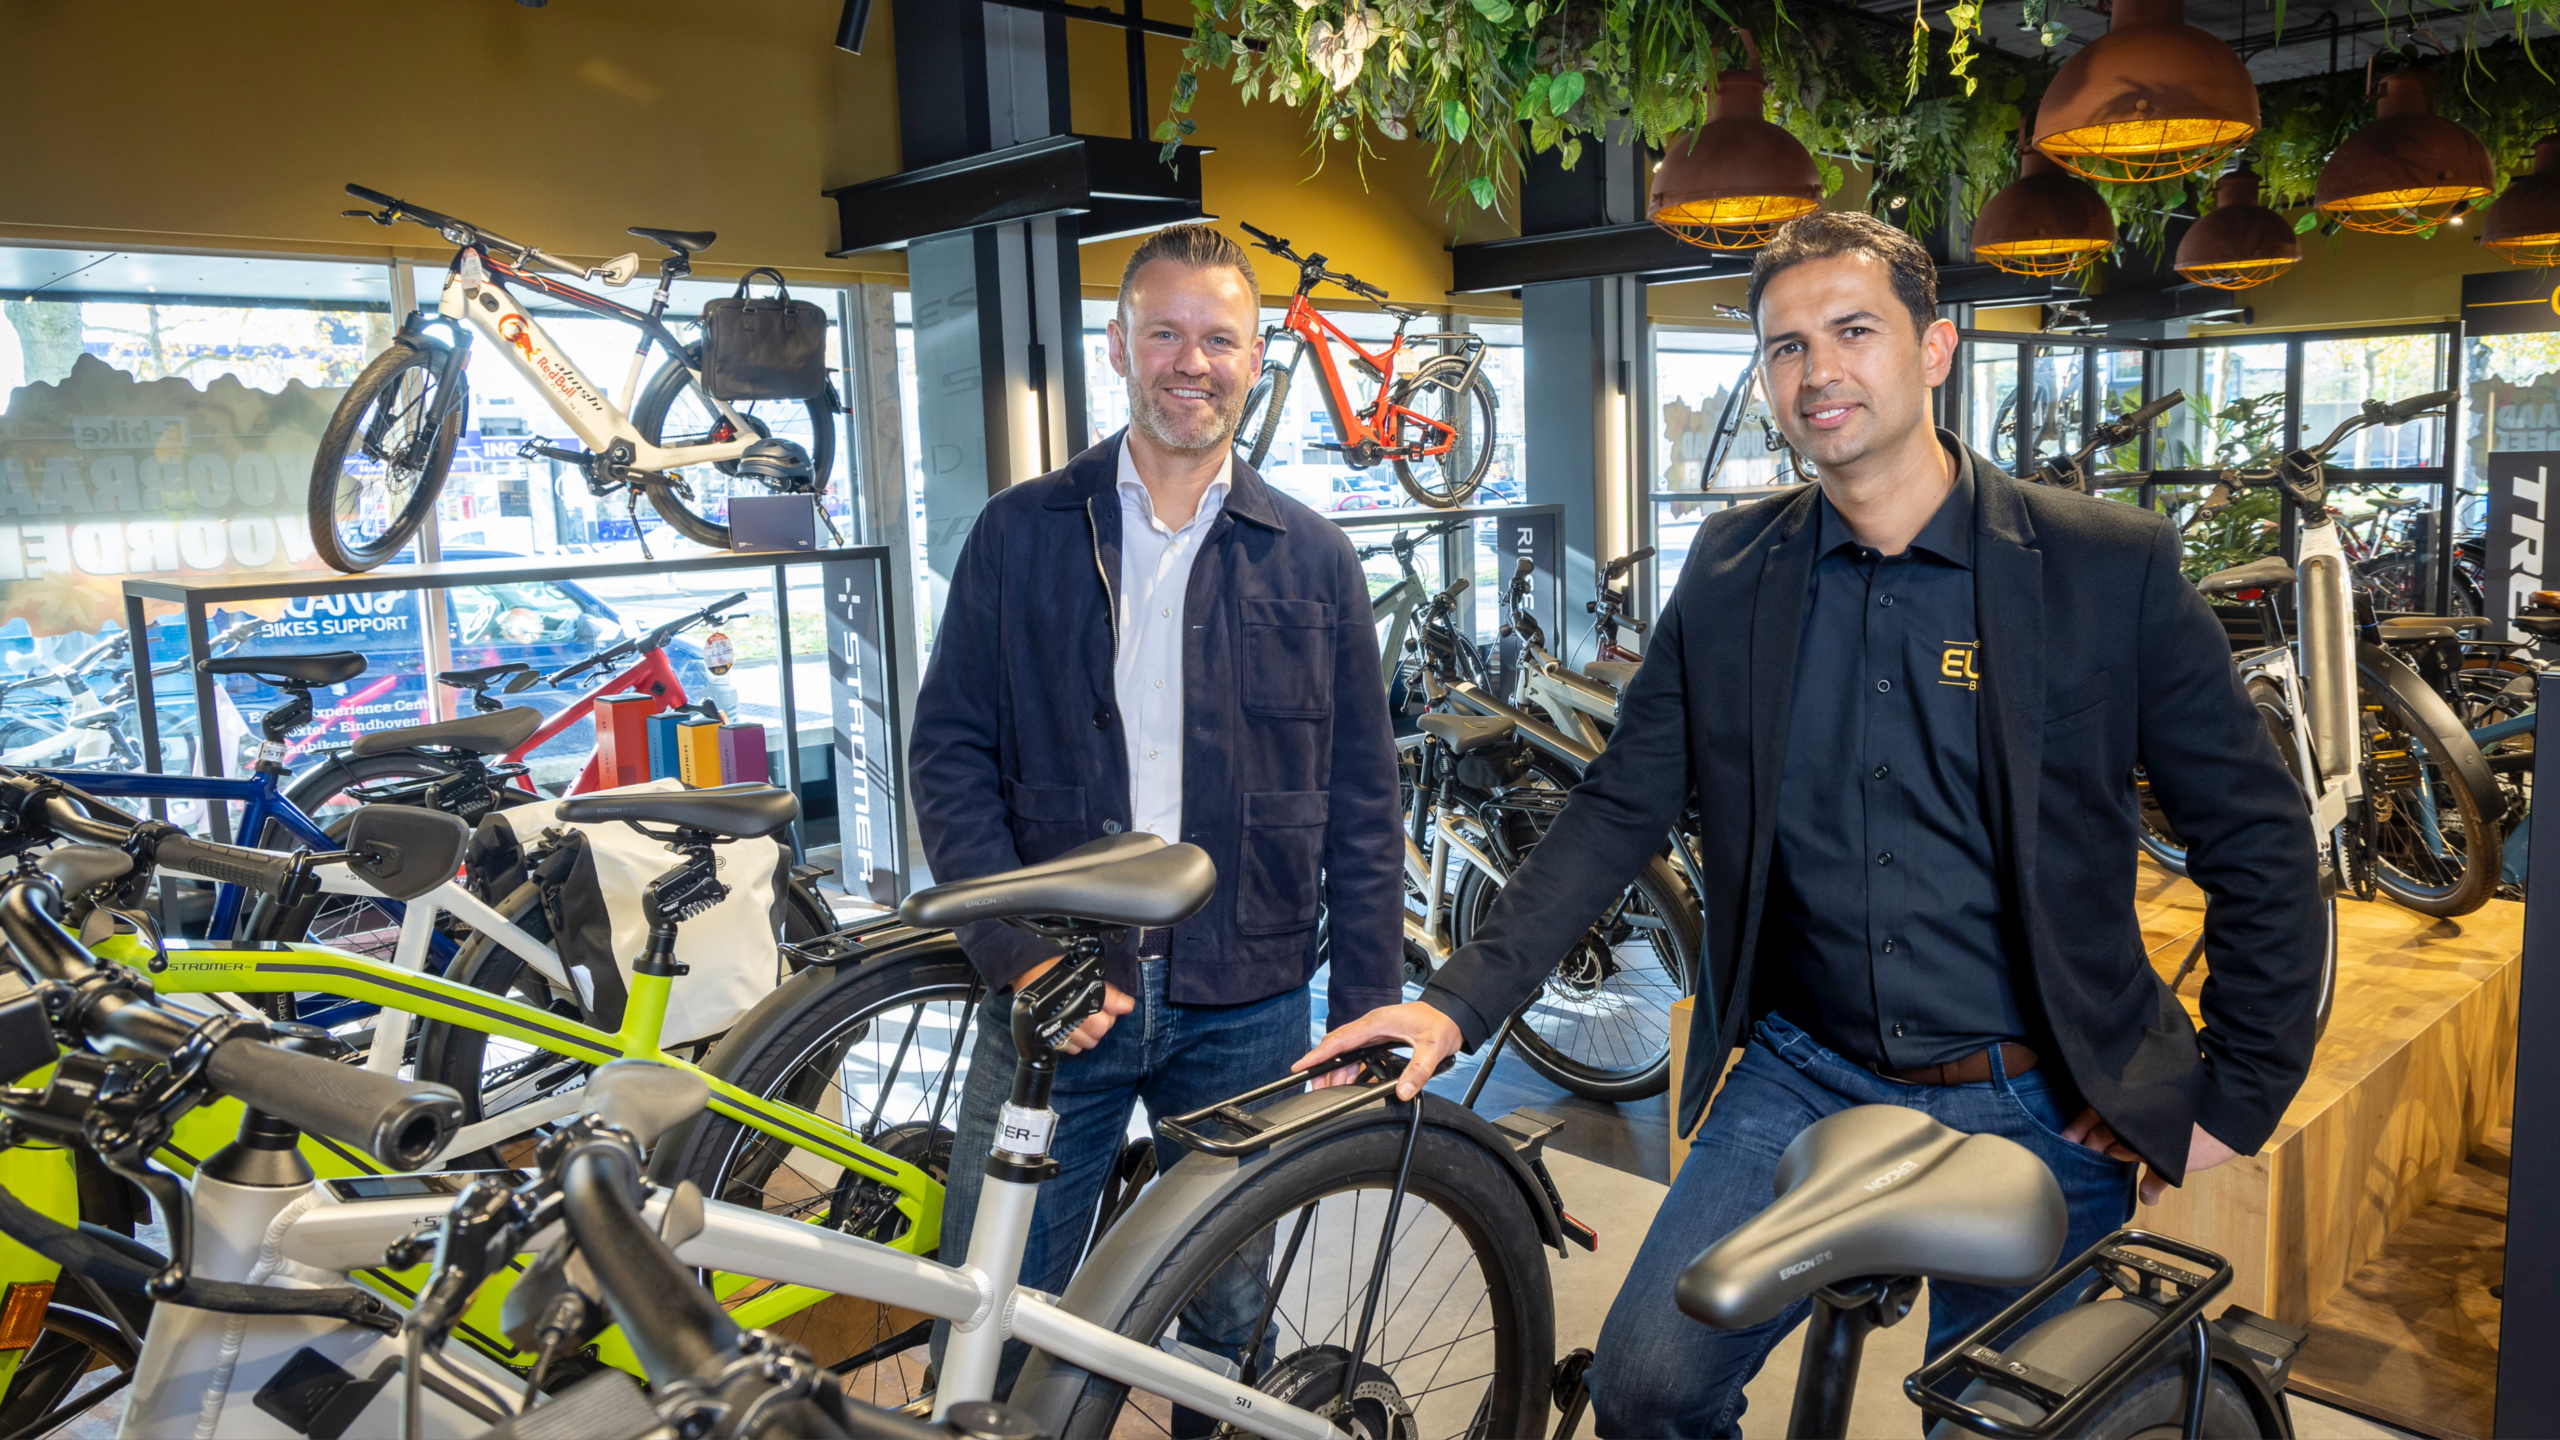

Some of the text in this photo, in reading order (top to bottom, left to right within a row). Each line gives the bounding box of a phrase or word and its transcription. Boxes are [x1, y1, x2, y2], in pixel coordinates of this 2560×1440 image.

[261, 615, 409, 638] BIKES SUPPORT
[339, 717, 420, 734] Eindhoven
[965, 897, 997, 908] ERGON
[1863, 1160, 1920, 1192] ERGON
[1778, 1258, 1816, 1281] ERGON
